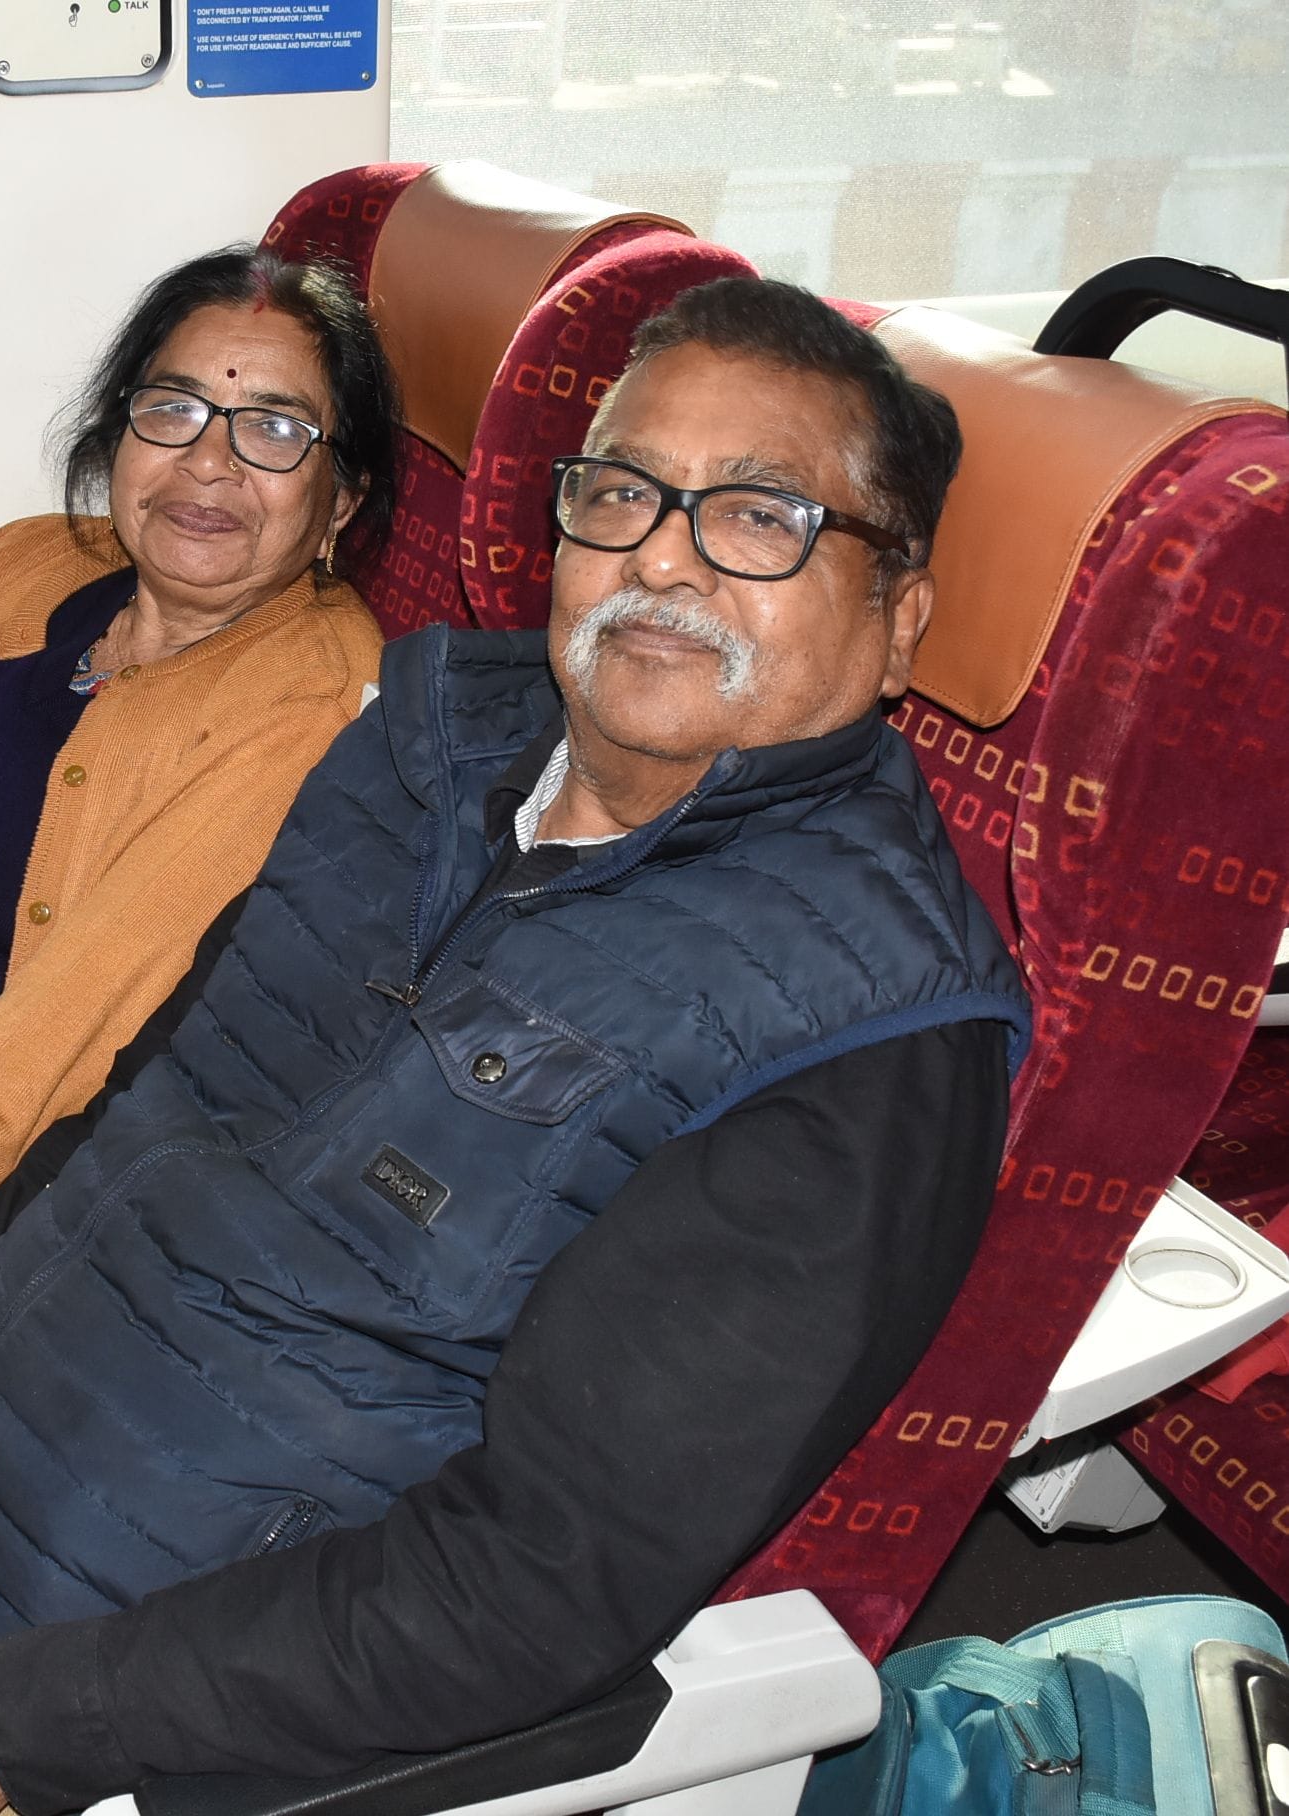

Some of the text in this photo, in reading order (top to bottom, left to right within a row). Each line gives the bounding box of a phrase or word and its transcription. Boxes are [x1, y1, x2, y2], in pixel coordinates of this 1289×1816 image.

[125, 1, 149, 9] TALK
[197, 8, 215, 16] DON'T
[197, 17, 241, 25] DISCONNECTED
[270, 15, 299, 23] OPERATOR
[295, 32, 319, 40] PENALTY
[249, 42, 286, 50] REASONABLE
